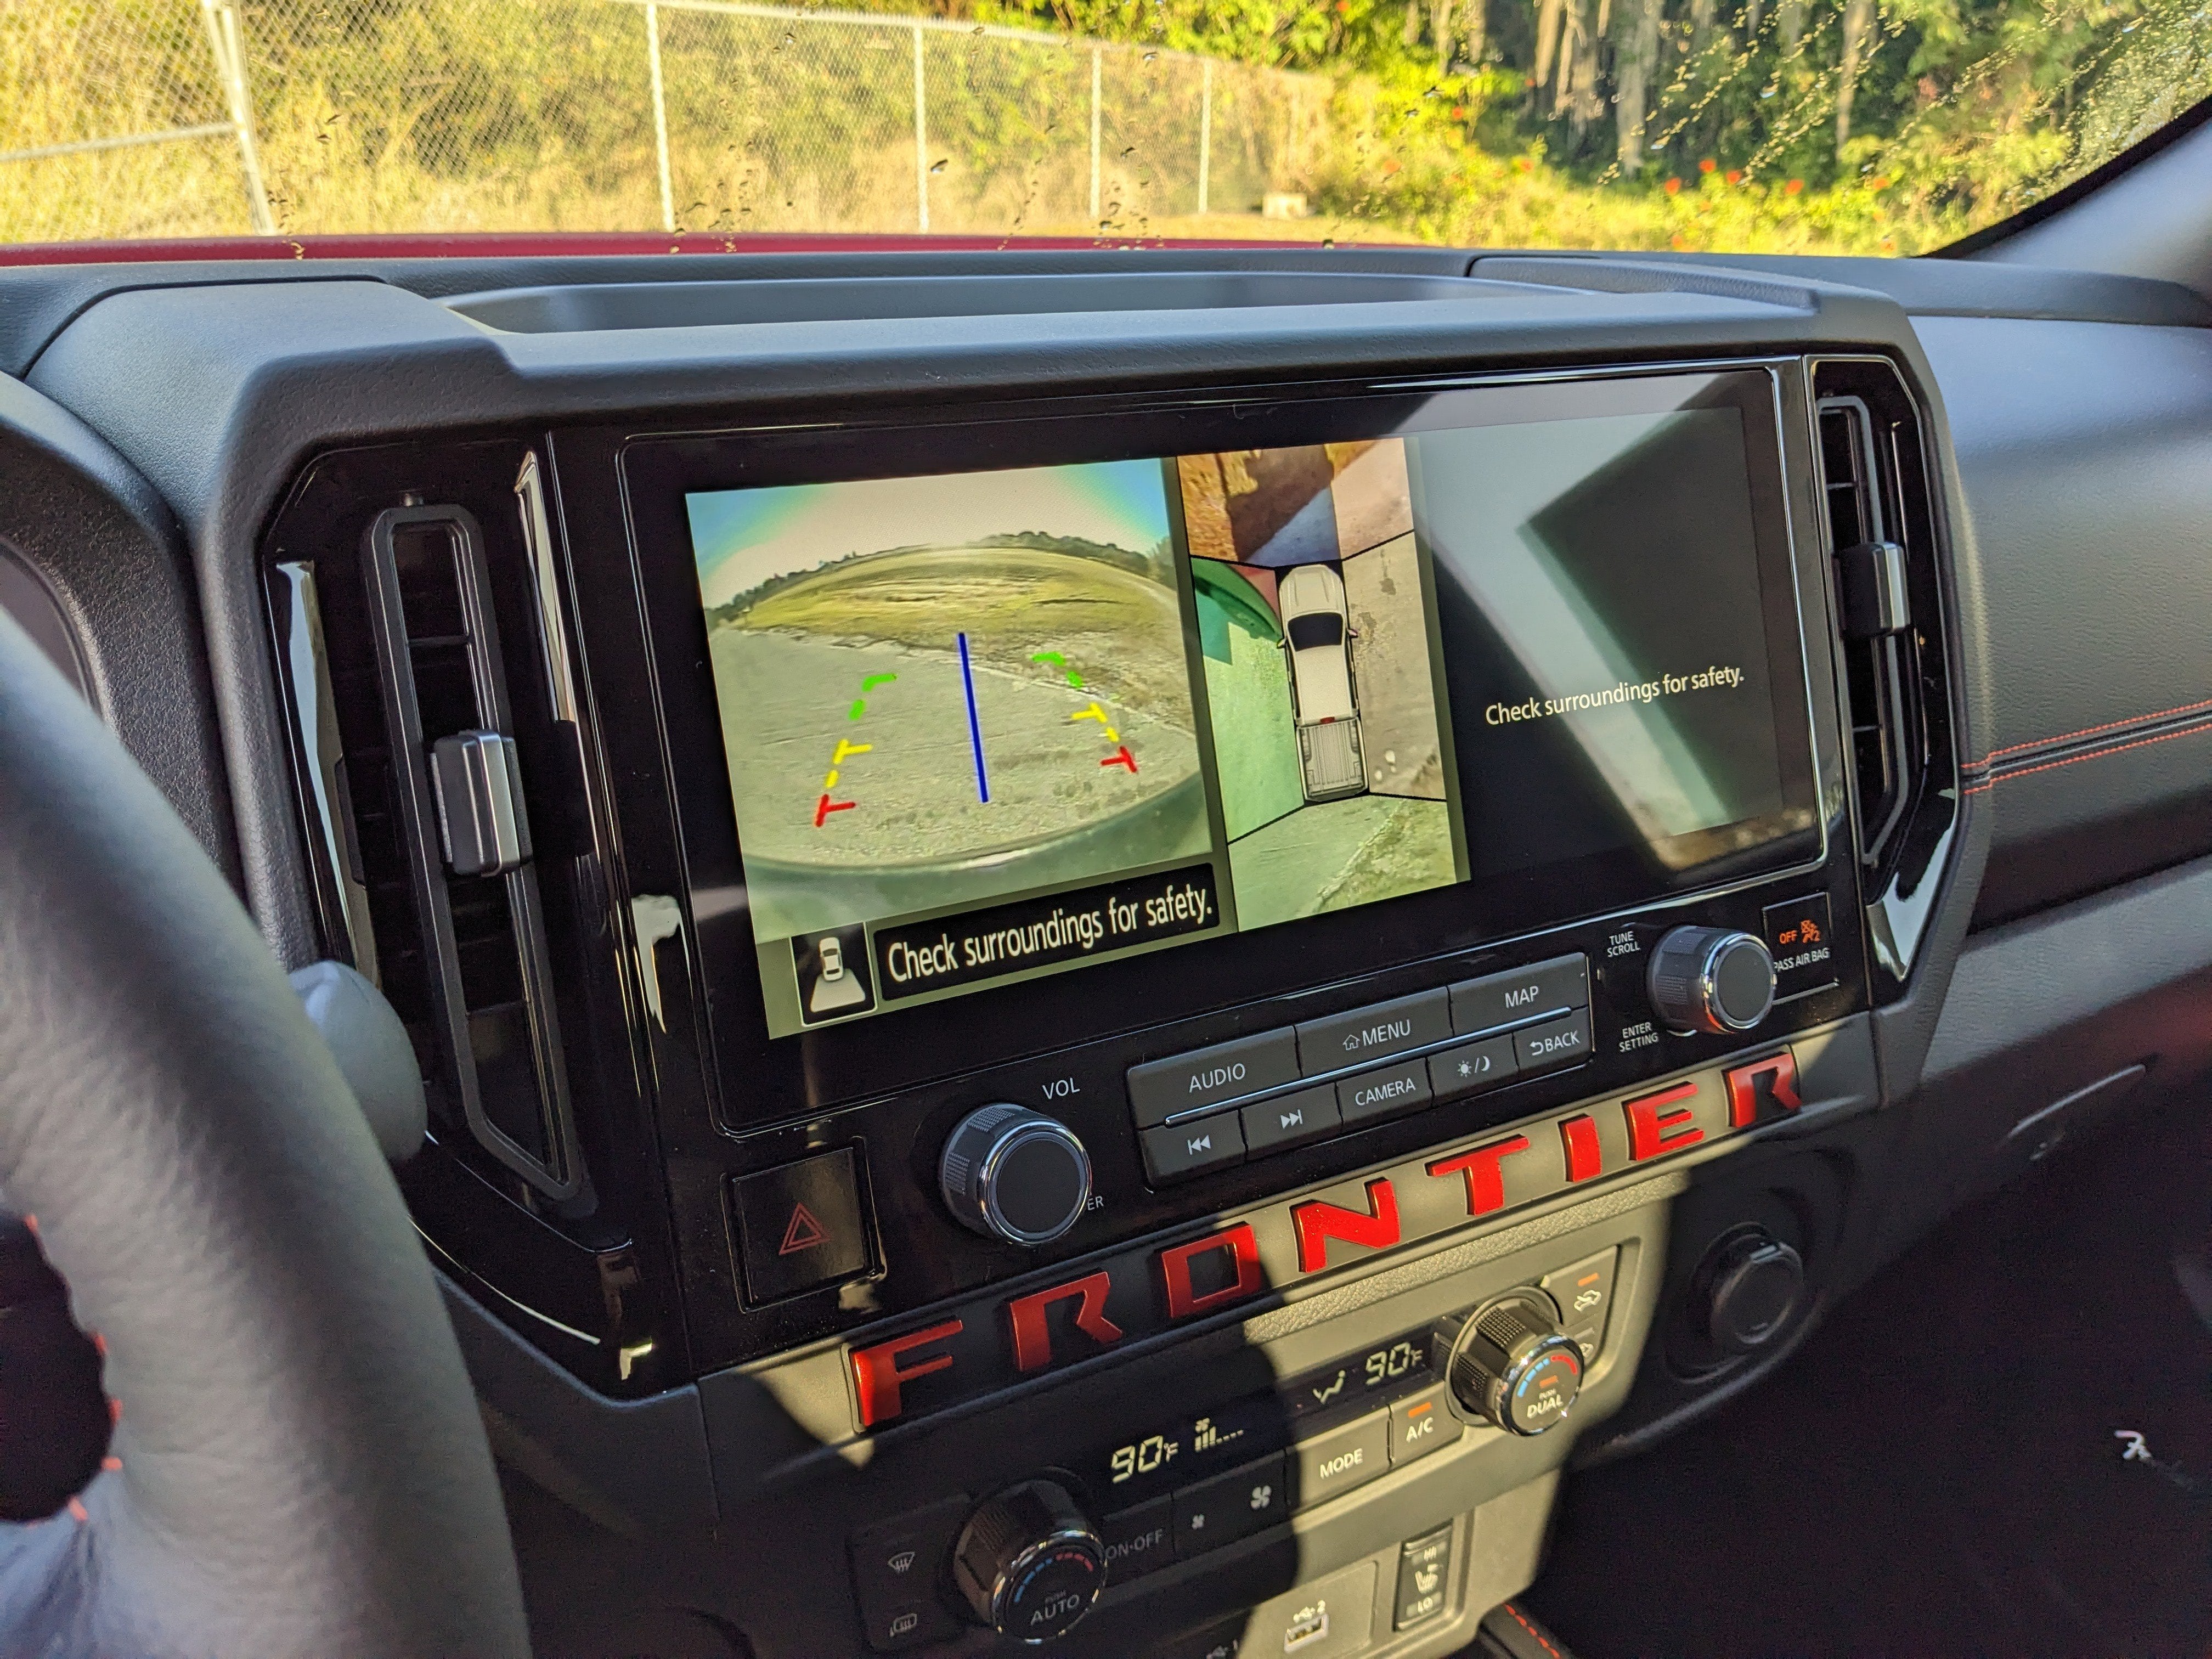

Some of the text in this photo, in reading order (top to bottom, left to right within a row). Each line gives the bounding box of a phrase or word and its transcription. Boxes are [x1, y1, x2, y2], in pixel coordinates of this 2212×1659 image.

[1486, 665, 1745, 725] Check surroundings for safety.
[888, 883, 1213, 983] Check surroundings for safety.
[1609, 930, 1634, 944] TUNE
[1779, 929, 1798, 944] OFF
[1607, 940, 1640, 958] SCROLL
[1795, 952, 1812, 967] AIR
[1811, 947, 1830, 962] BAG
[1504, 985, 1539, 1008] MAP
[1362, 1019, 1411, 1047] MENU
[1545, 1030, 1581, 1052] BACK
[1619, 1031, 1659, 1053] SETTING
[1622, 1022, 1652, 1039] ENTER
[1042, 1076, 1081, 1100] VOL
[1188, 1063, 1246, 1093] AUDIO
[1355, 1077, 1417, 1107] CAMERA
[850, 1052, 1805, 1427] FRONTIER
[1527, 1394, 1564, 1419] DUAL
[1406, 1417, 1434, 1443] A/C
[1319, 1448, 1364, 1479] MODE
[1030, 1594, 1080, 1627] AUTO
